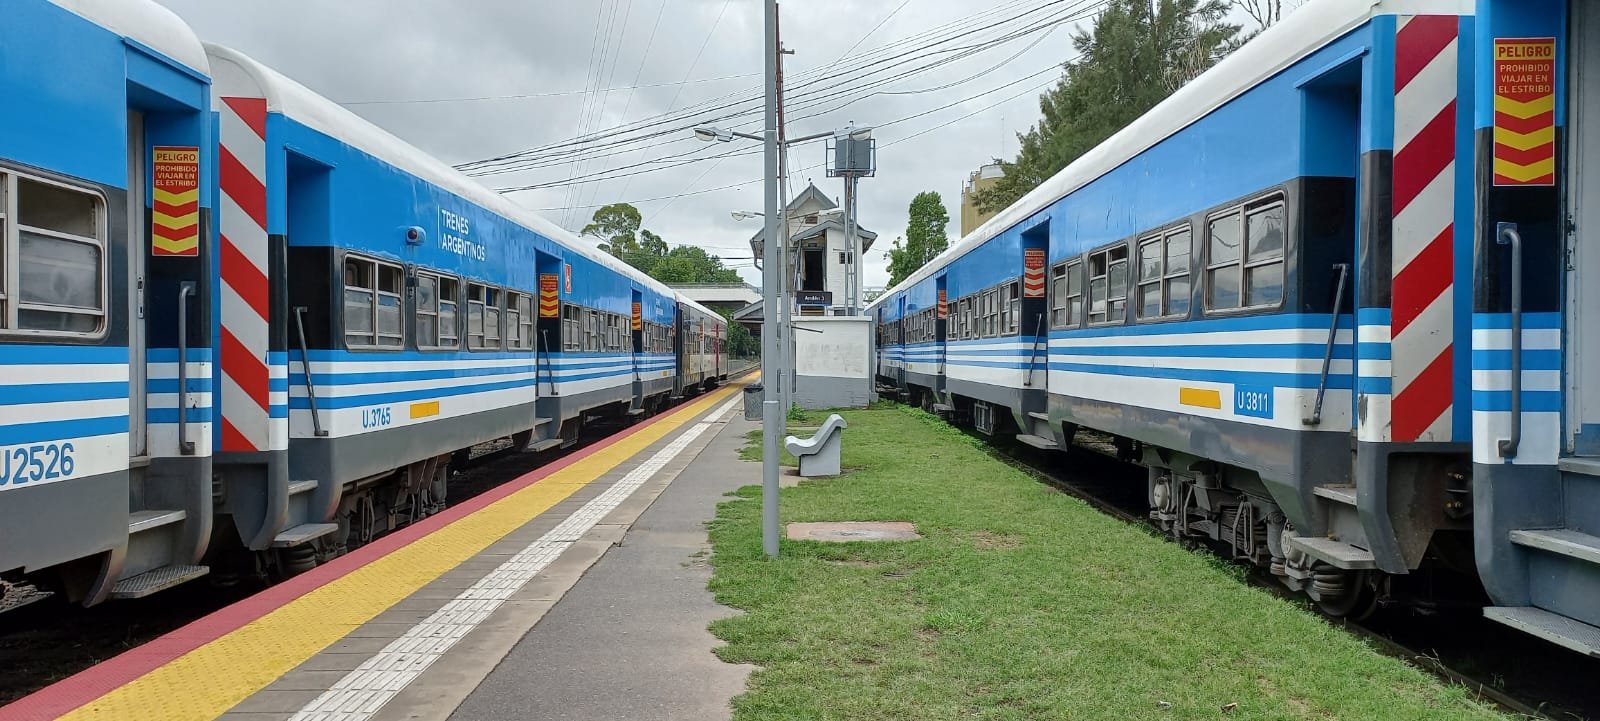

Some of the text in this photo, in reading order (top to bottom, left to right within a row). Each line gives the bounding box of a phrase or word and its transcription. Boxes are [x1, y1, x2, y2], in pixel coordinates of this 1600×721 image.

[1498, 46, 1551, 57] PELIGRO
[1500, 64, 1550, 72] PROHIBIDO
[1501, 75, 1533, 83] VIAJAR
[1511, 85, 1550, 93] ESTRIBO
[156, 153, 196, 161] PELIGRO
[441, 209, 469, 235] TRENES
[441, 233, 486, 261] ARGENTINOS
[1237, 391, 1269, 413] U 3811
[362, 407, 391, 428] U.3765
[0, 443, 75, 485] U2526
